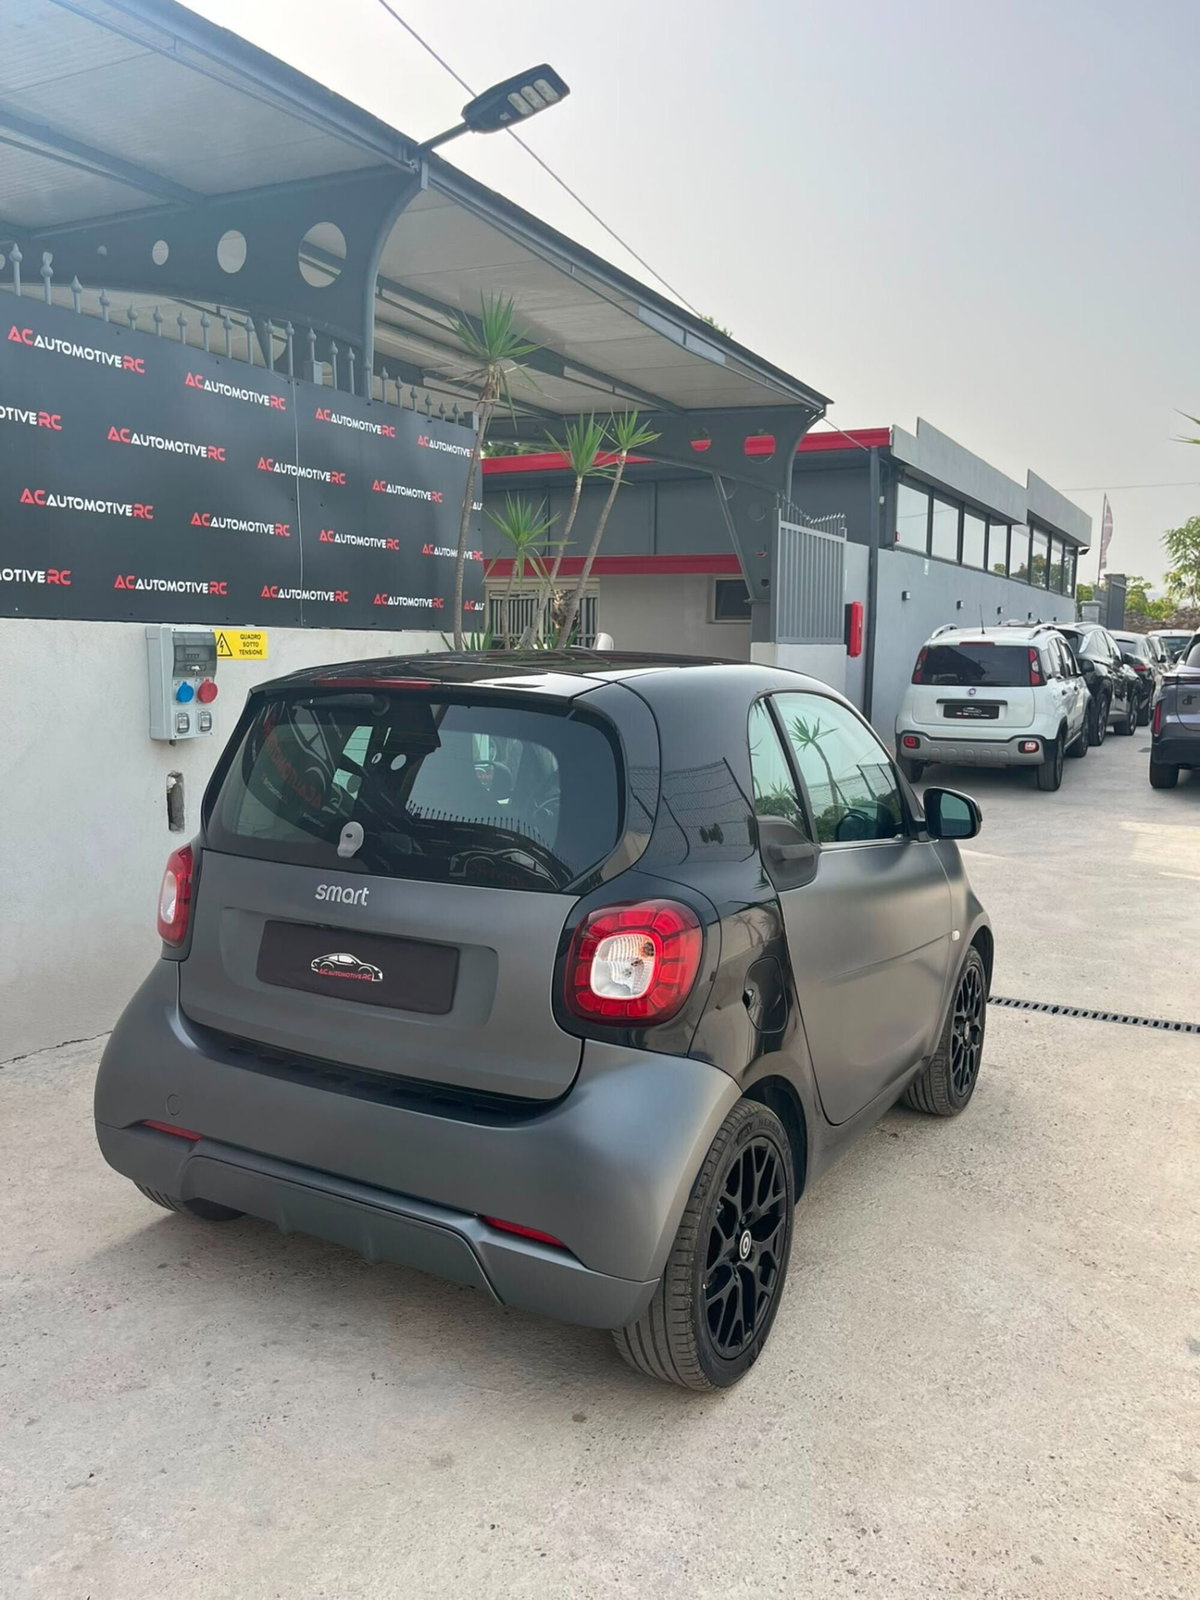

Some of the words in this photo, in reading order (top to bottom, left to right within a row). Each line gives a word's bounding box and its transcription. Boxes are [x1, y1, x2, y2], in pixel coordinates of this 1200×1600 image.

[7, 325, 145, 373] ACAUTOMOTIVERC
[185, 372, 286, 410] ACAUTOMOTIVERC
[315, 408, 396, 438] ACAUTOMOTIVERC
[107, 426, 226, 461] ACAUTOMOTIVERC
[257, 457, 346, 486] ACAUTOMOTIVERC
[20, 488, 154, 519] ACAUTOMOTIVERC
[372, 480, 443, 503] ACAUTOMOTIVERC
[191, 512, 290, 537] ACAUTOMOTIVERC
[319, 529, 399, 550] ACAUTOMOTIVERC
[114, 575, 228, 596] ACAUTOMOTIVERC
[260, 585, 349, 603] ACAUTOMOTIVERC
[374, 593, 444, 608] ACAUTOMOTIVERC
[315, 884, 370, 906] smart
